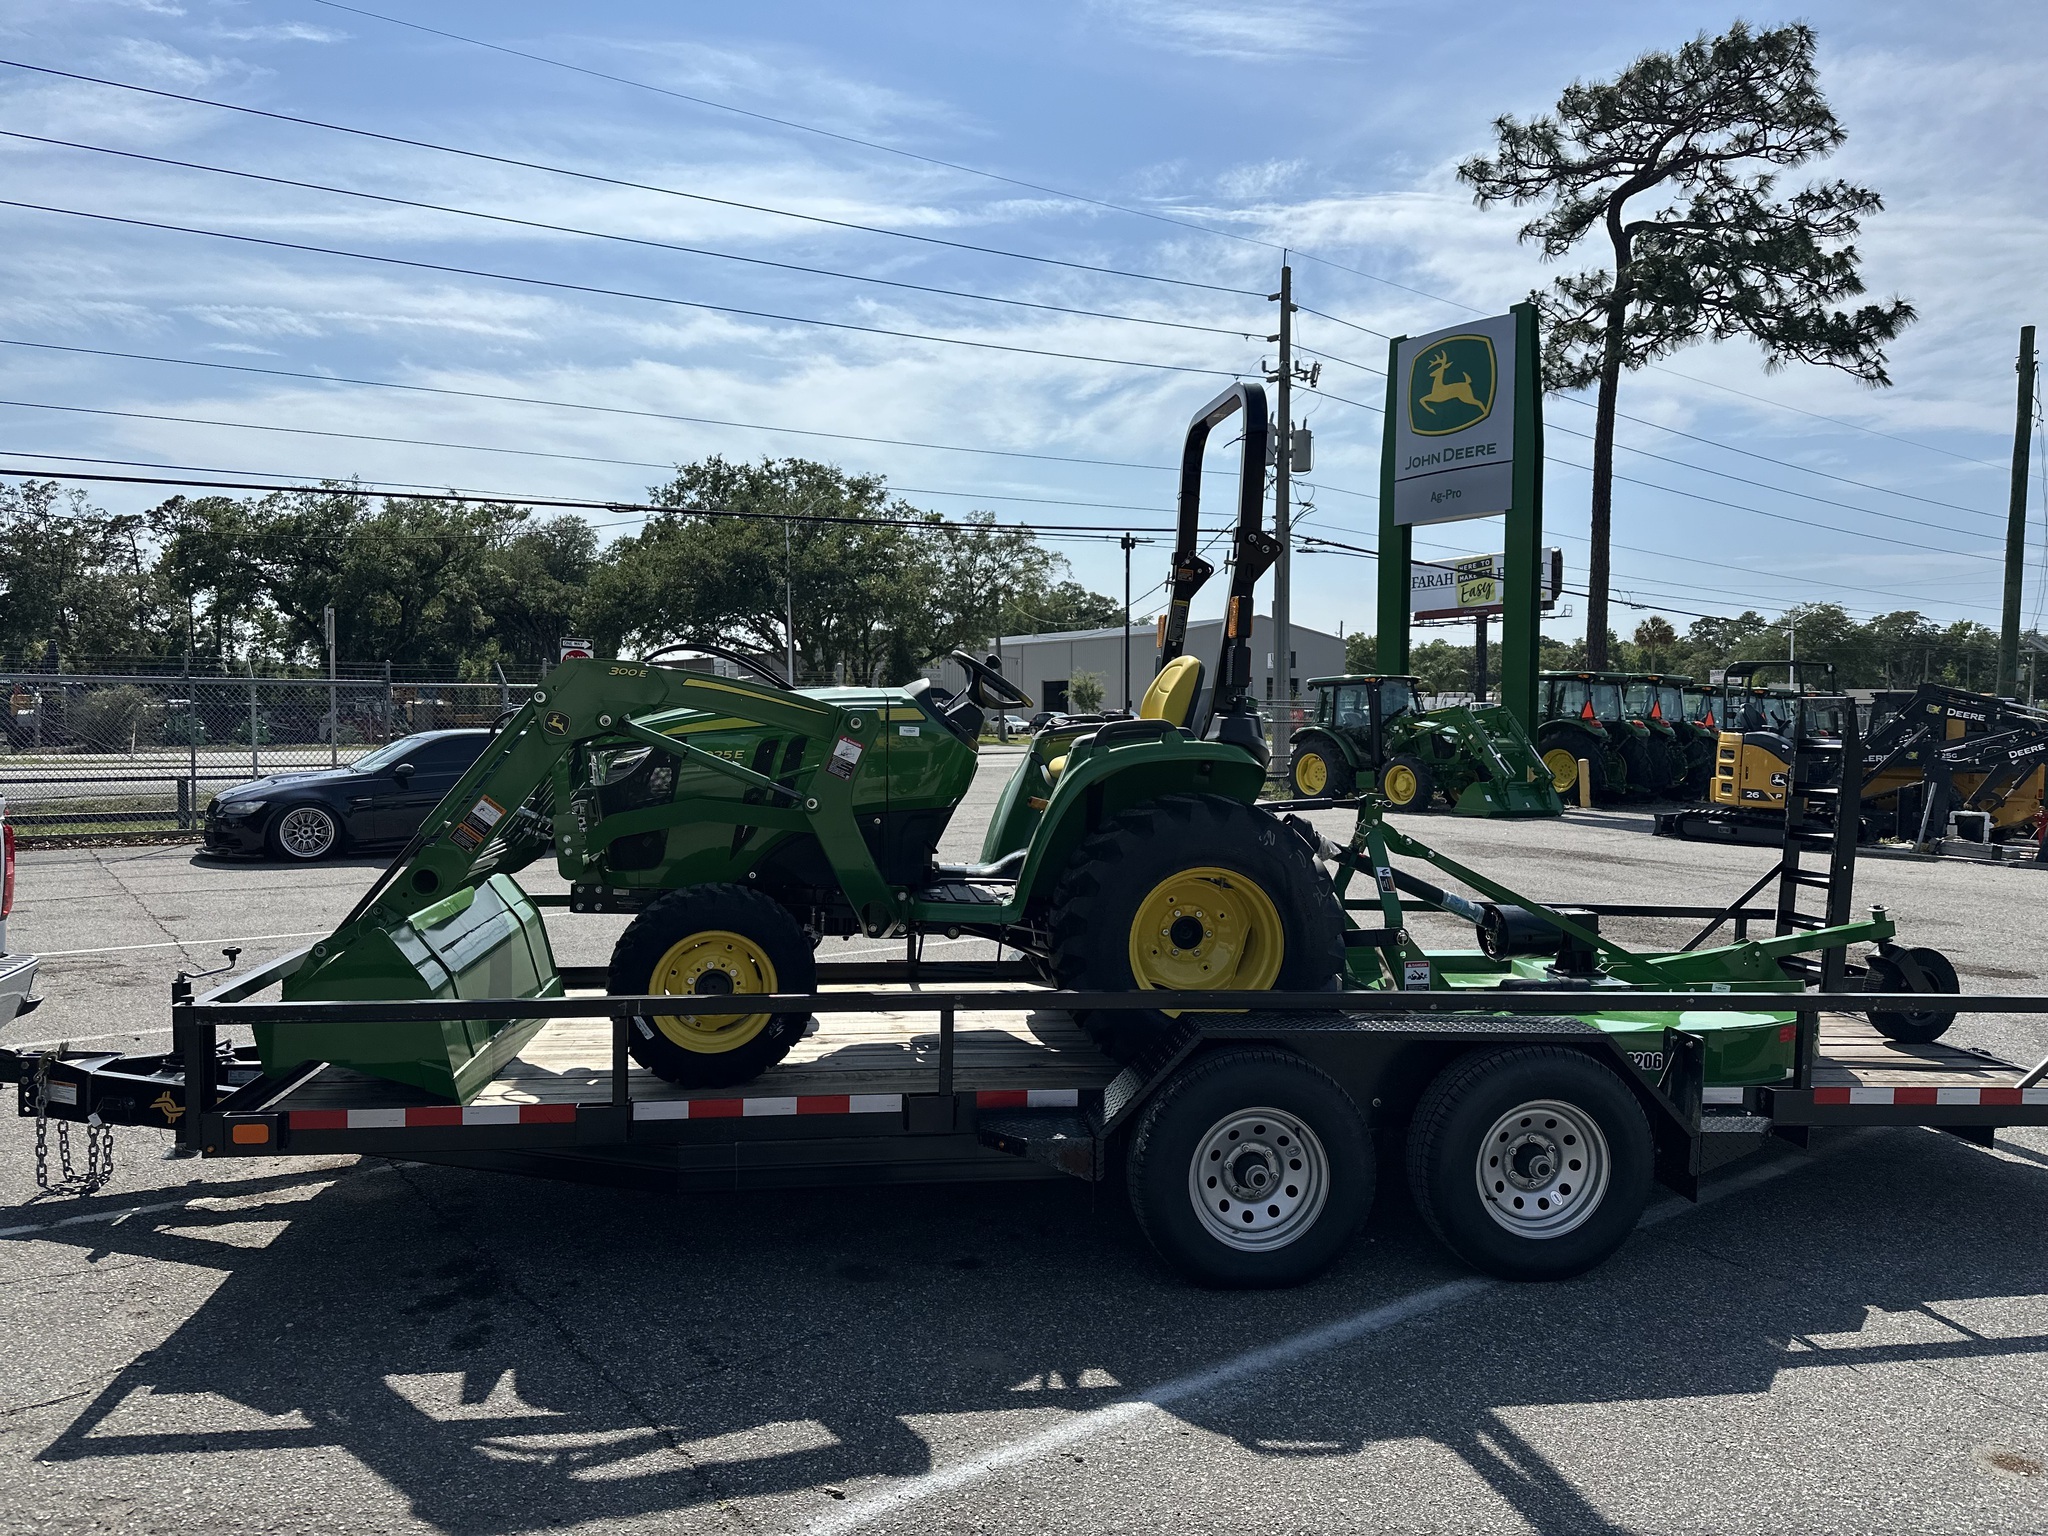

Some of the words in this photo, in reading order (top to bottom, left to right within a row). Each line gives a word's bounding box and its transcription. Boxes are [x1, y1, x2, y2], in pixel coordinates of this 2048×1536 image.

[1405, 452, 1441, 471] JOHN
[1443, 443, 1497, 463] DEERE
[1431, 489, 1462, 503] Ag-Pro
[1459, 563, 1477, 571] HERE
[1412, 573, 1454, 589] FARAH
[1461, 582, 1493, 603] Easy
[1947, 708, 1986, 722] DEERE
[2008, 743, 2046, 759] DEERE
[1746, 791, 1759, 799] 26
